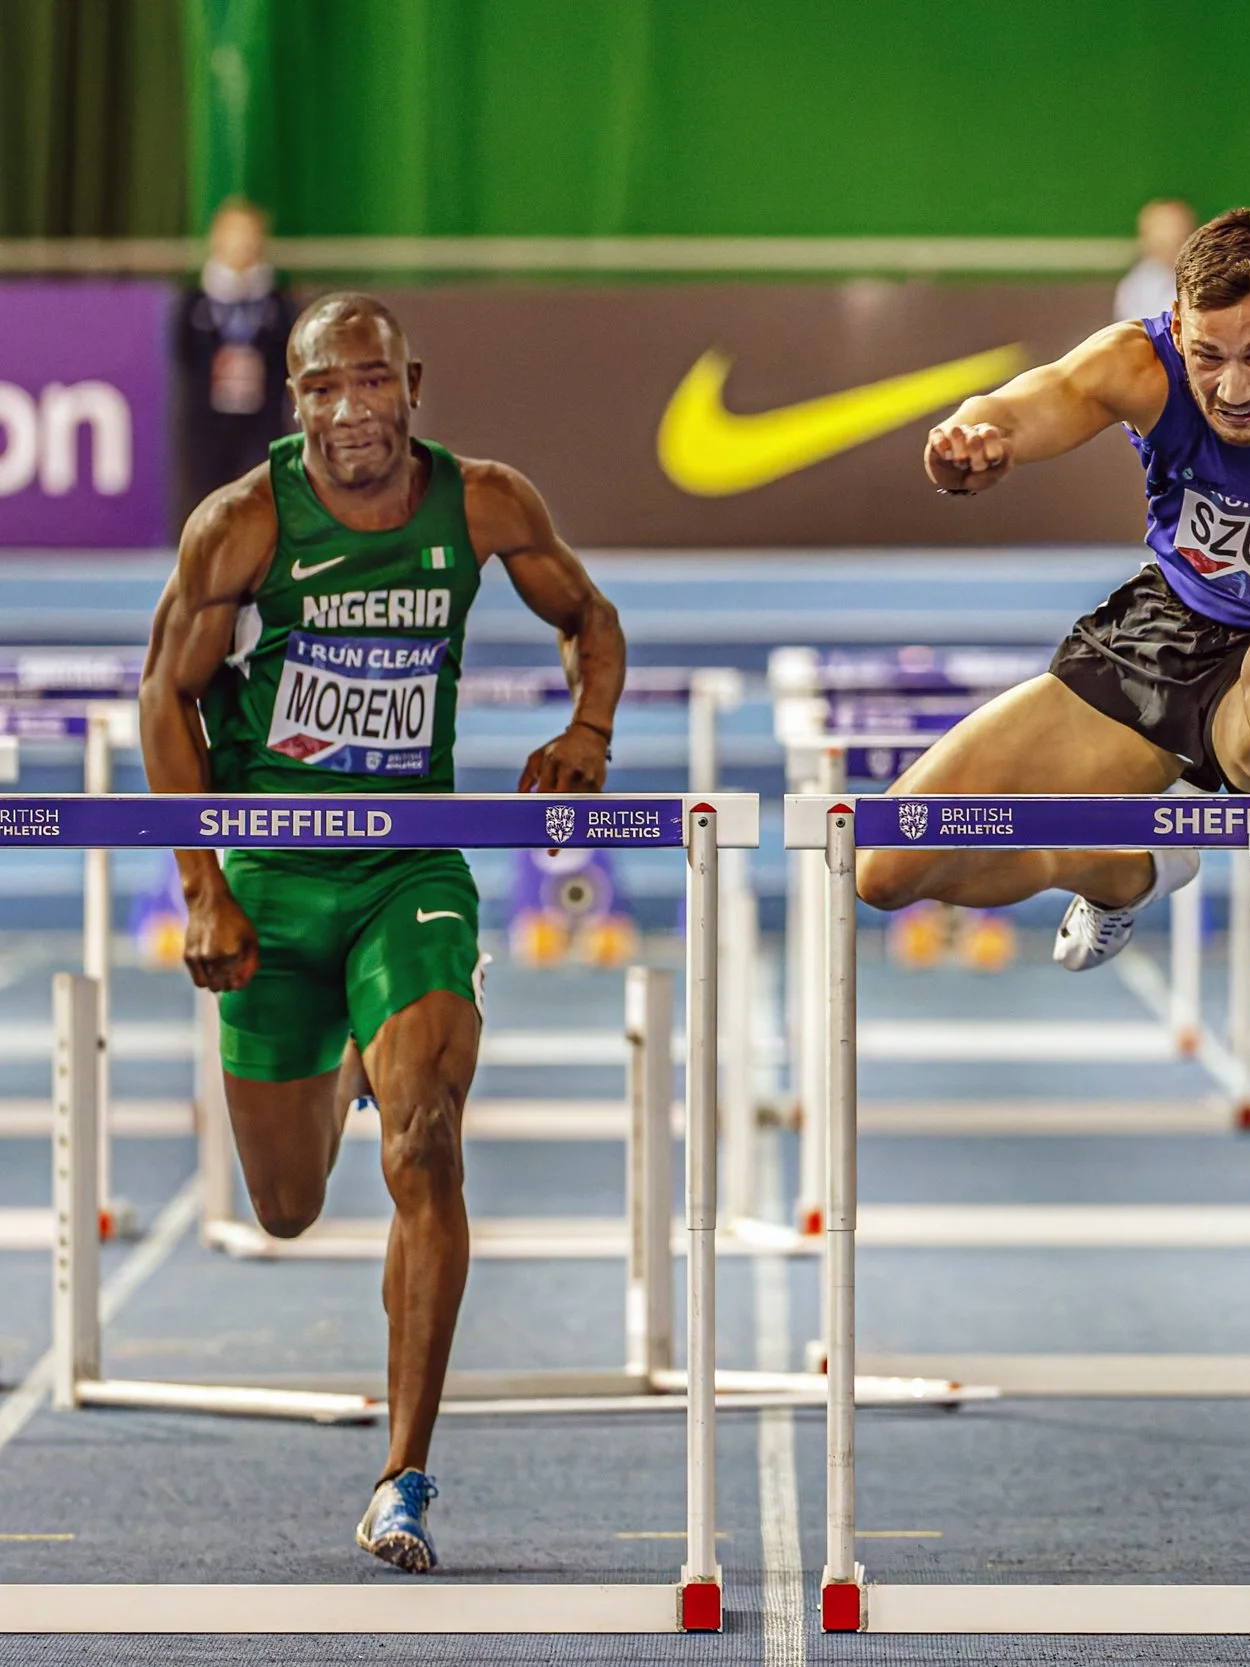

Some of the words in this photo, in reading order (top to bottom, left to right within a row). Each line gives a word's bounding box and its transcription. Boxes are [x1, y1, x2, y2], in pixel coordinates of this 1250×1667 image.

[302, 588, 451, 628] NIGERIA
[298, 640, 305, 656] I
[311, 643, 362, 668] RUN
[367, 648, 438, 669] CLEAN
[286, 671, 425, 740] MORENO
[0, 809, 59, 823] RITISH
[588, 811, 659, 825] BRITISH
[941, 808, 1012, 822] BRITISH
[199, 809, 393, 836] SHEFFIELD
[940, 824, 1014, 835] ATHLETICS
[0, 825, 60, 836] HLETICS
[586, 827, 661, 838] ATHLETICS
